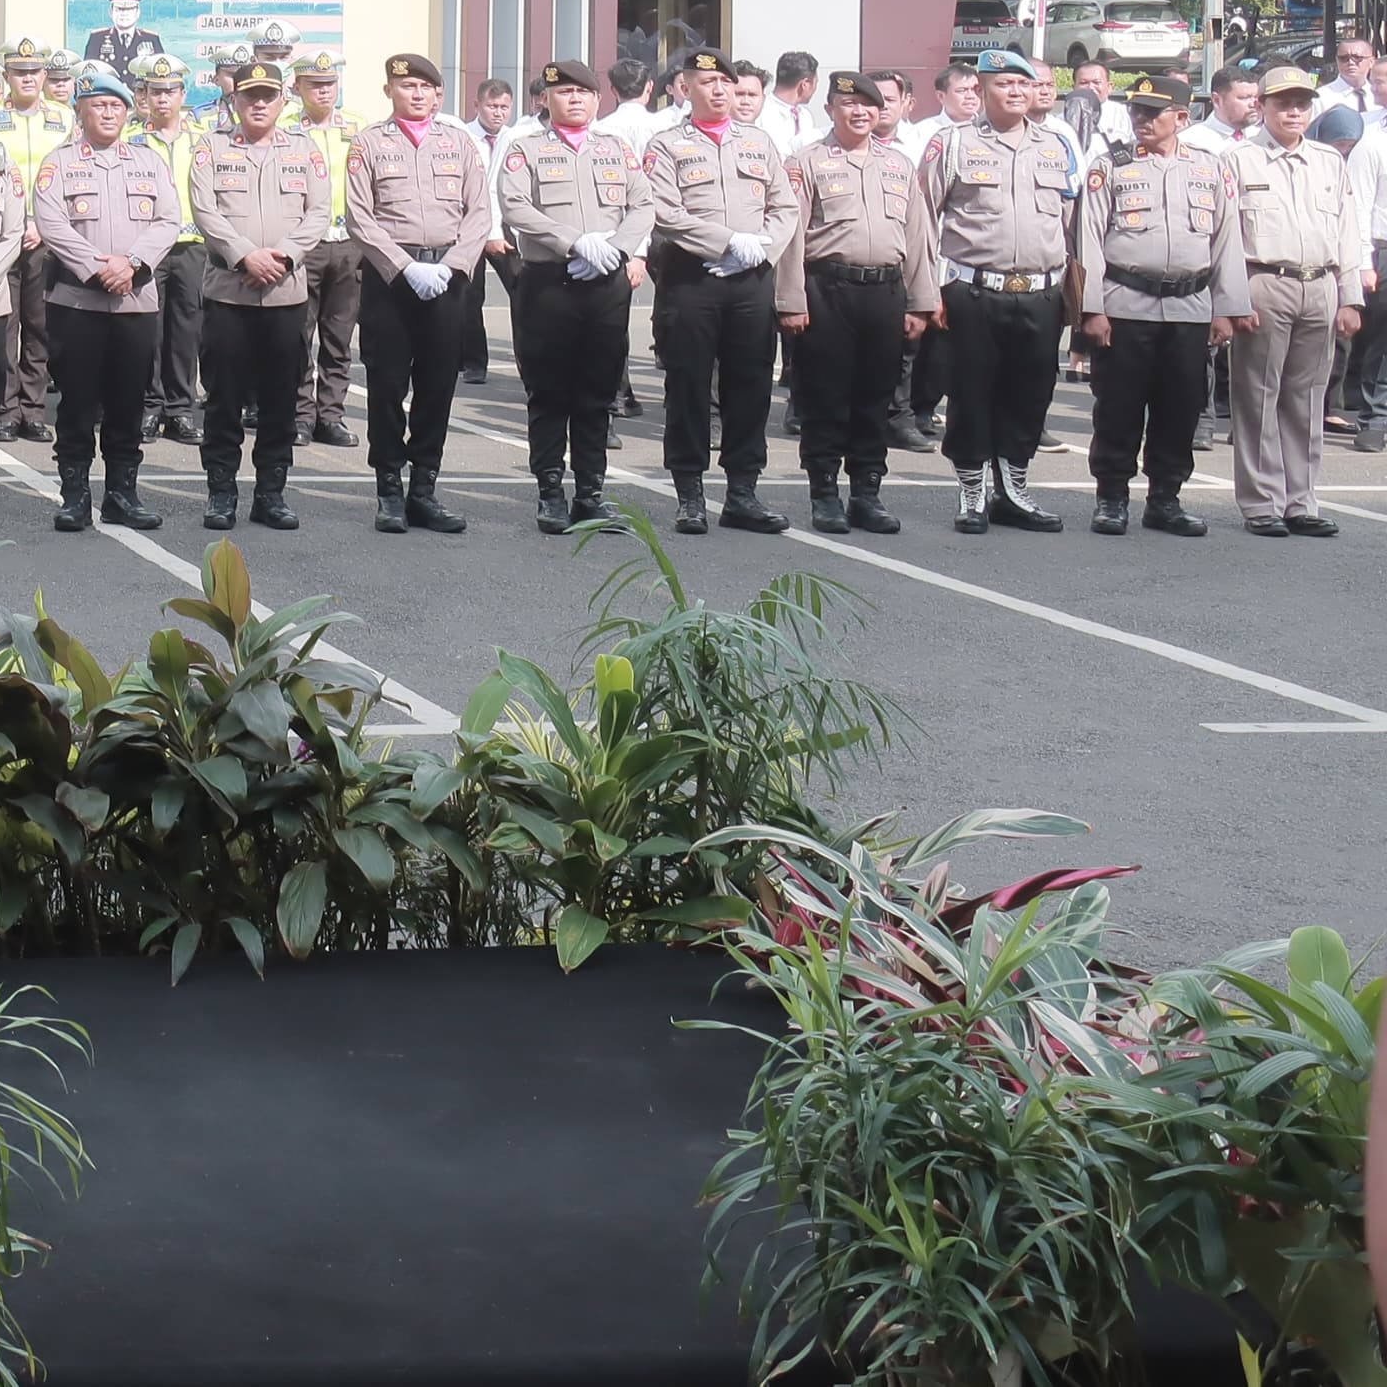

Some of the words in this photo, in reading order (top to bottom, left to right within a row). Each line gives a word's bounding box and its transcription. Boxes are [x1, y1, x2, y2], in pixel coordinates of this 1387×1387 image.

[201, 17, 229, 29] JAGA
[432, 153, 460, 161] POLRI
[738, 152, 766, 160] POLRI
[592, 157, 622, 166] POLRI
[1036, 161, 1063, 170] POLRI
[127, 171, 155, 179] POLRI
[282, 166, 307, 175] POLRI
[882, 172, 908, 181] POLRI
